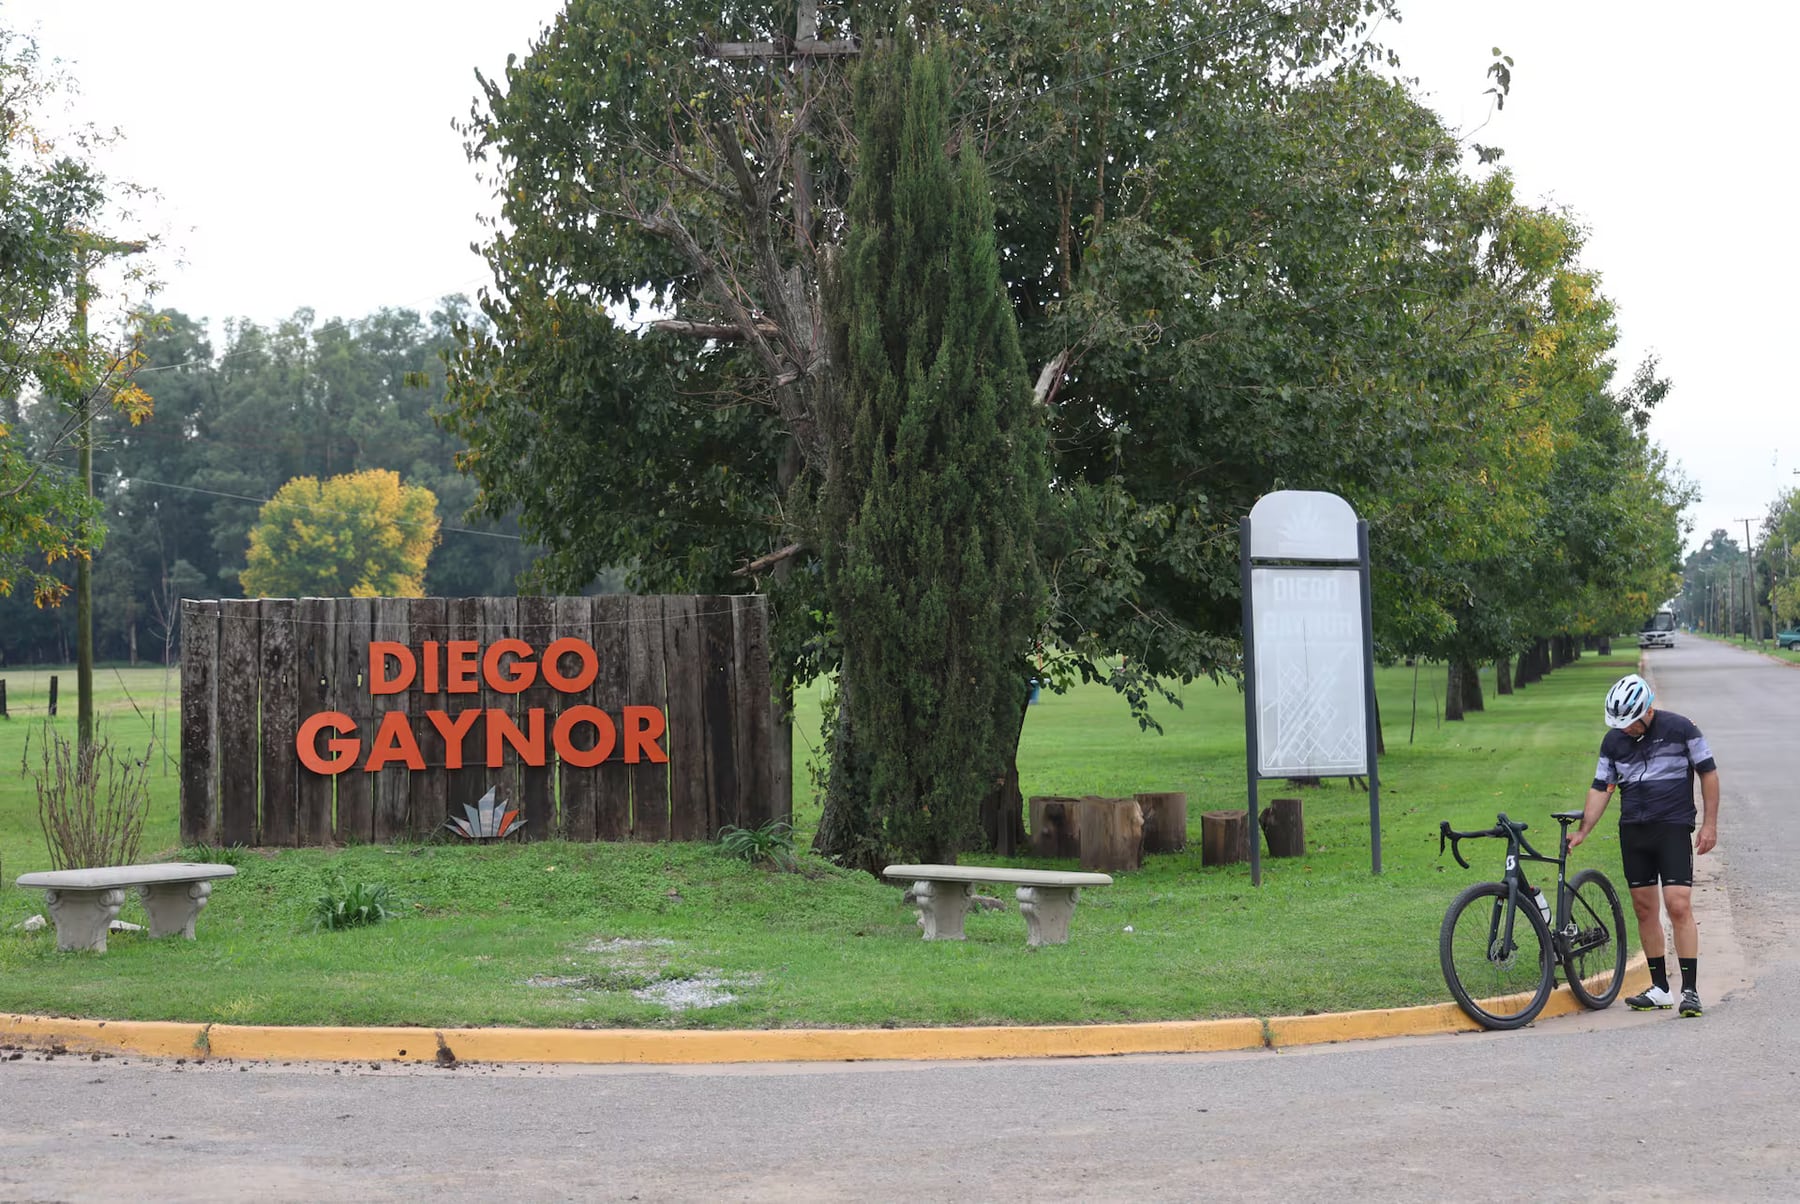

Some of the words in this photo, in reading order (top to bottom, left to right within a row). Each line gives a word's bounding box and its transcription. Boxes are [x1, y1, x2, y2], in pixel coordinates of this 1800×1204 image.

[1273, 577, 1339, 601] DIEGO
[369, 637, 599, 694] DIEGO
[296, 704, 670, 775] GAYNOR
